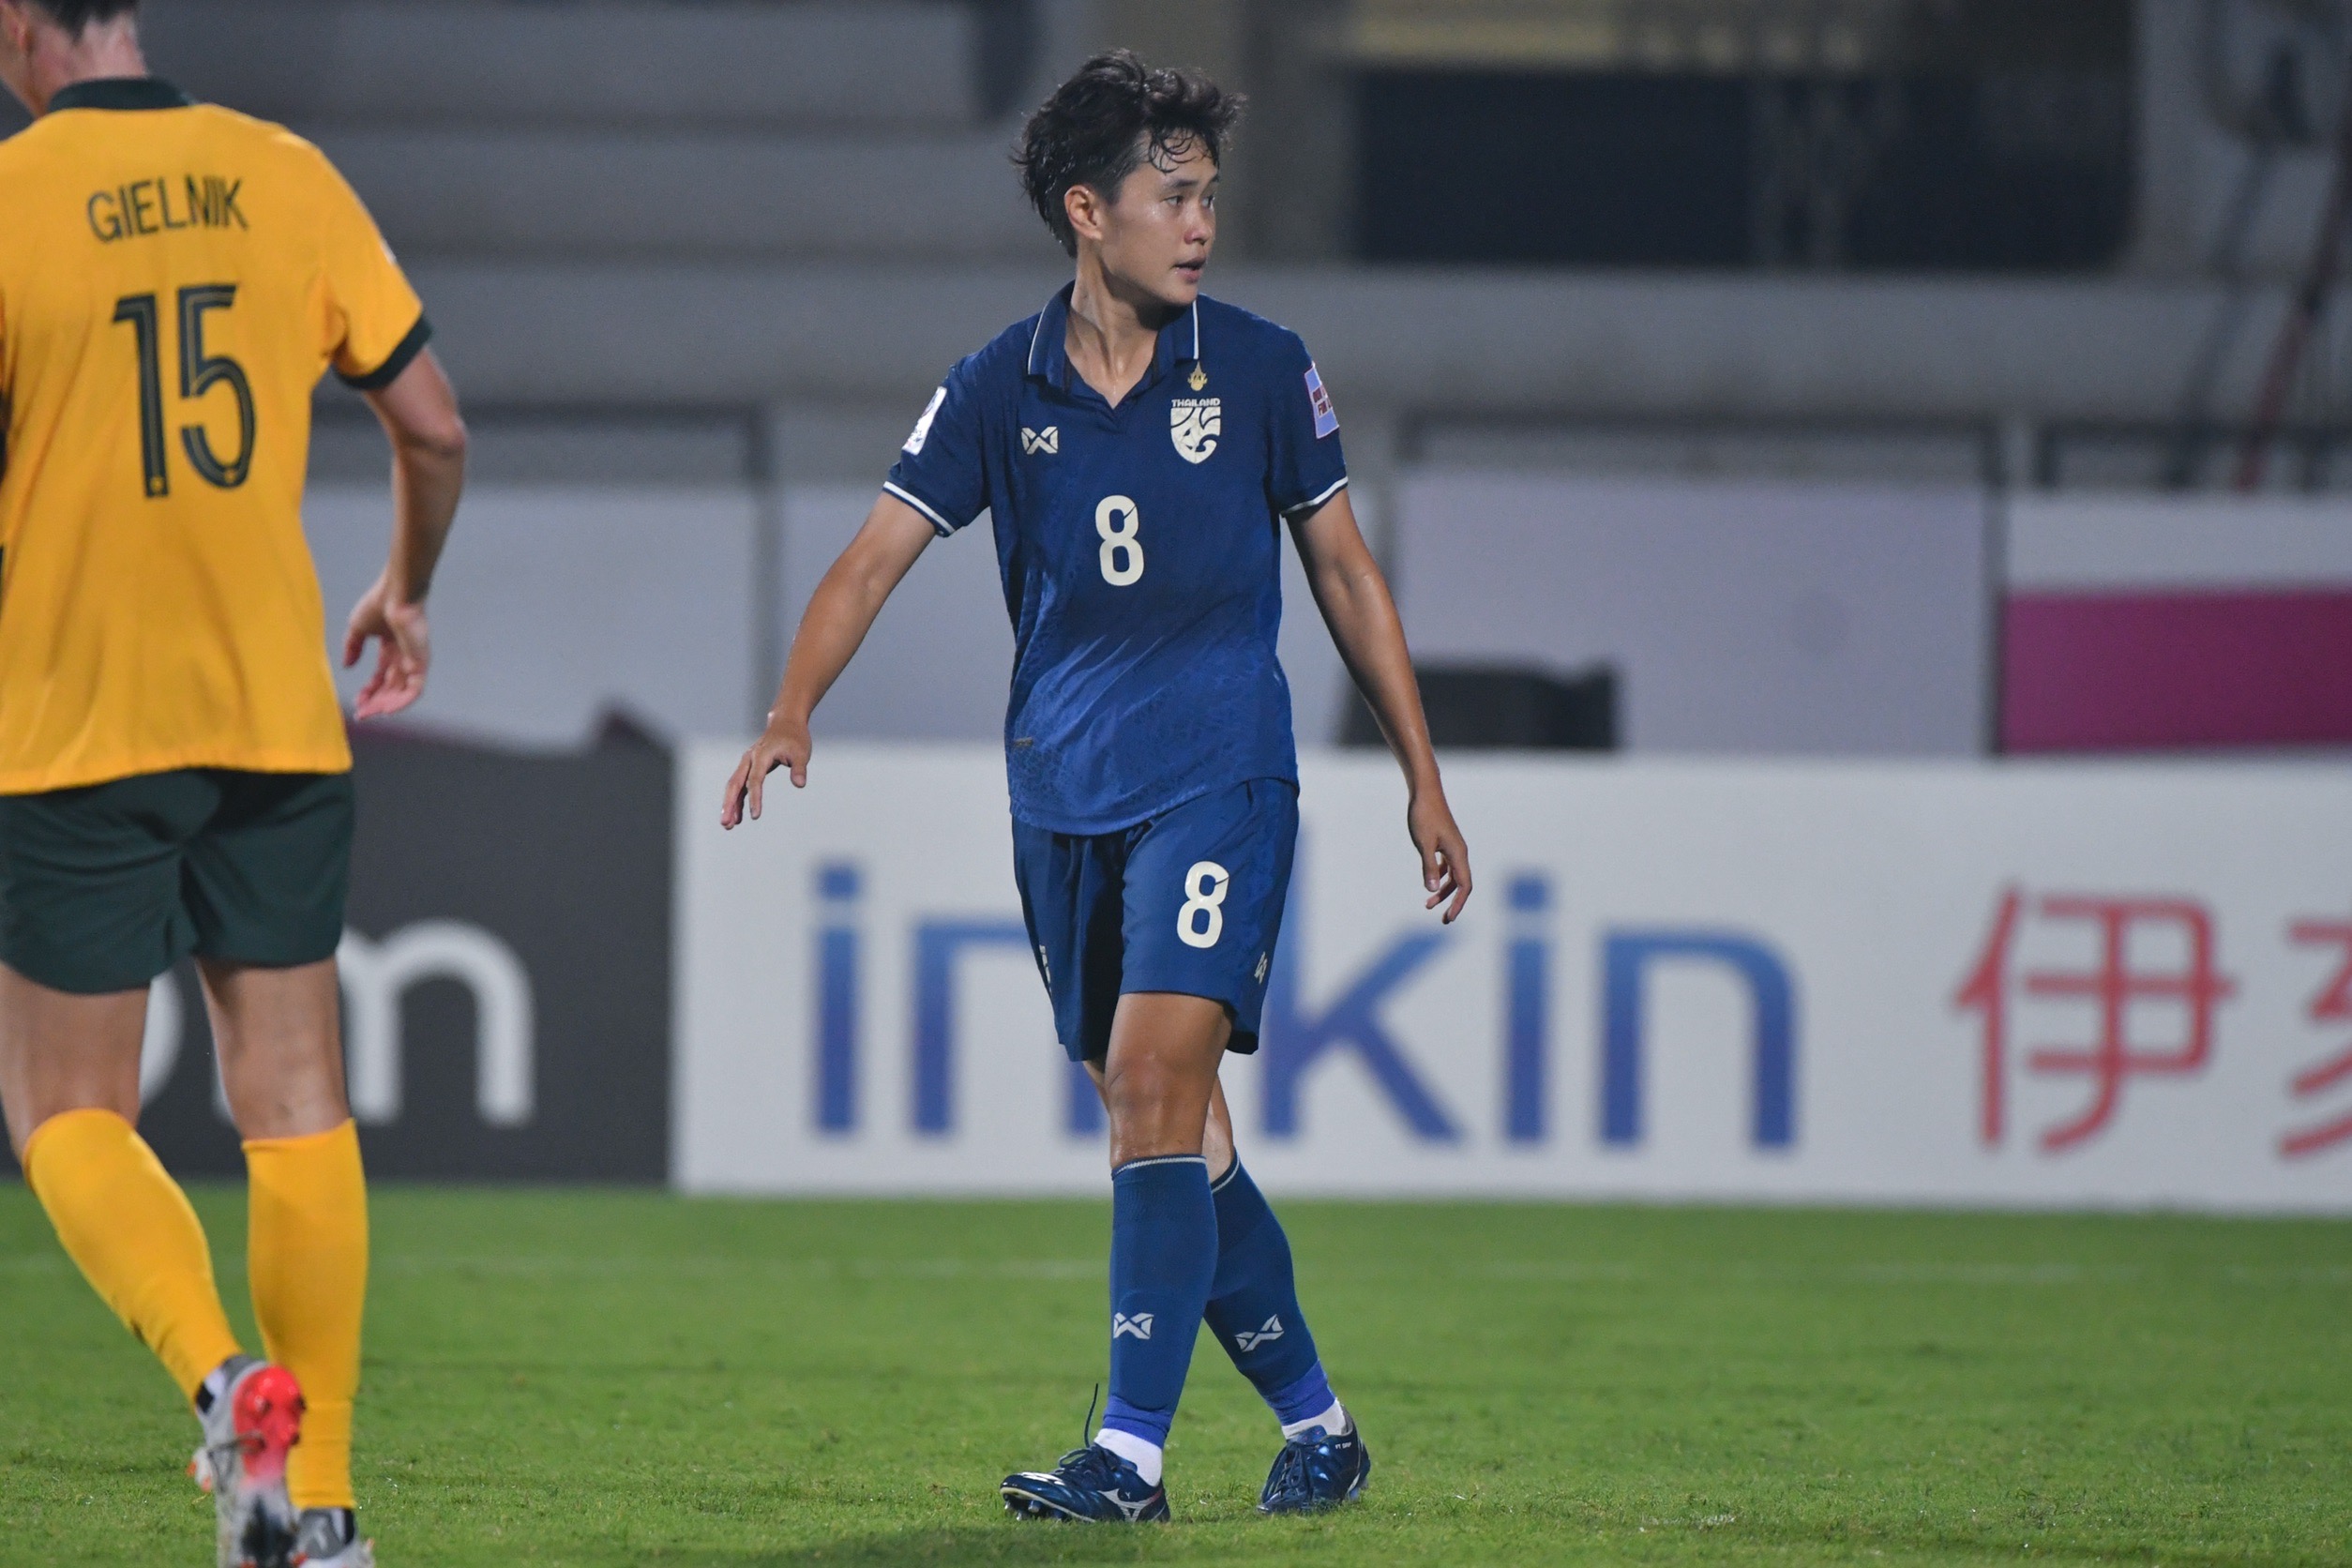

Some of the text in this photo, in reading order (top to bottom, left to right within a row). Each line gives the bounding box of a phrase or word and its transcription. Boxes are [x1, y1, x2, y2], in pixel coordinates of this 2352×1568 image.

[87, 174, 249, 243] GIELNIK
[113, 283, 255, 498] 15
[1171, 398, 1221, 407] THAILAND
[1095, 495, 1144, 586] 8
[1177, 861, 1229, 949] 8
[812, 820, 1798, 1142] inkin
[1954, 882, 2352, 1157] 伊
